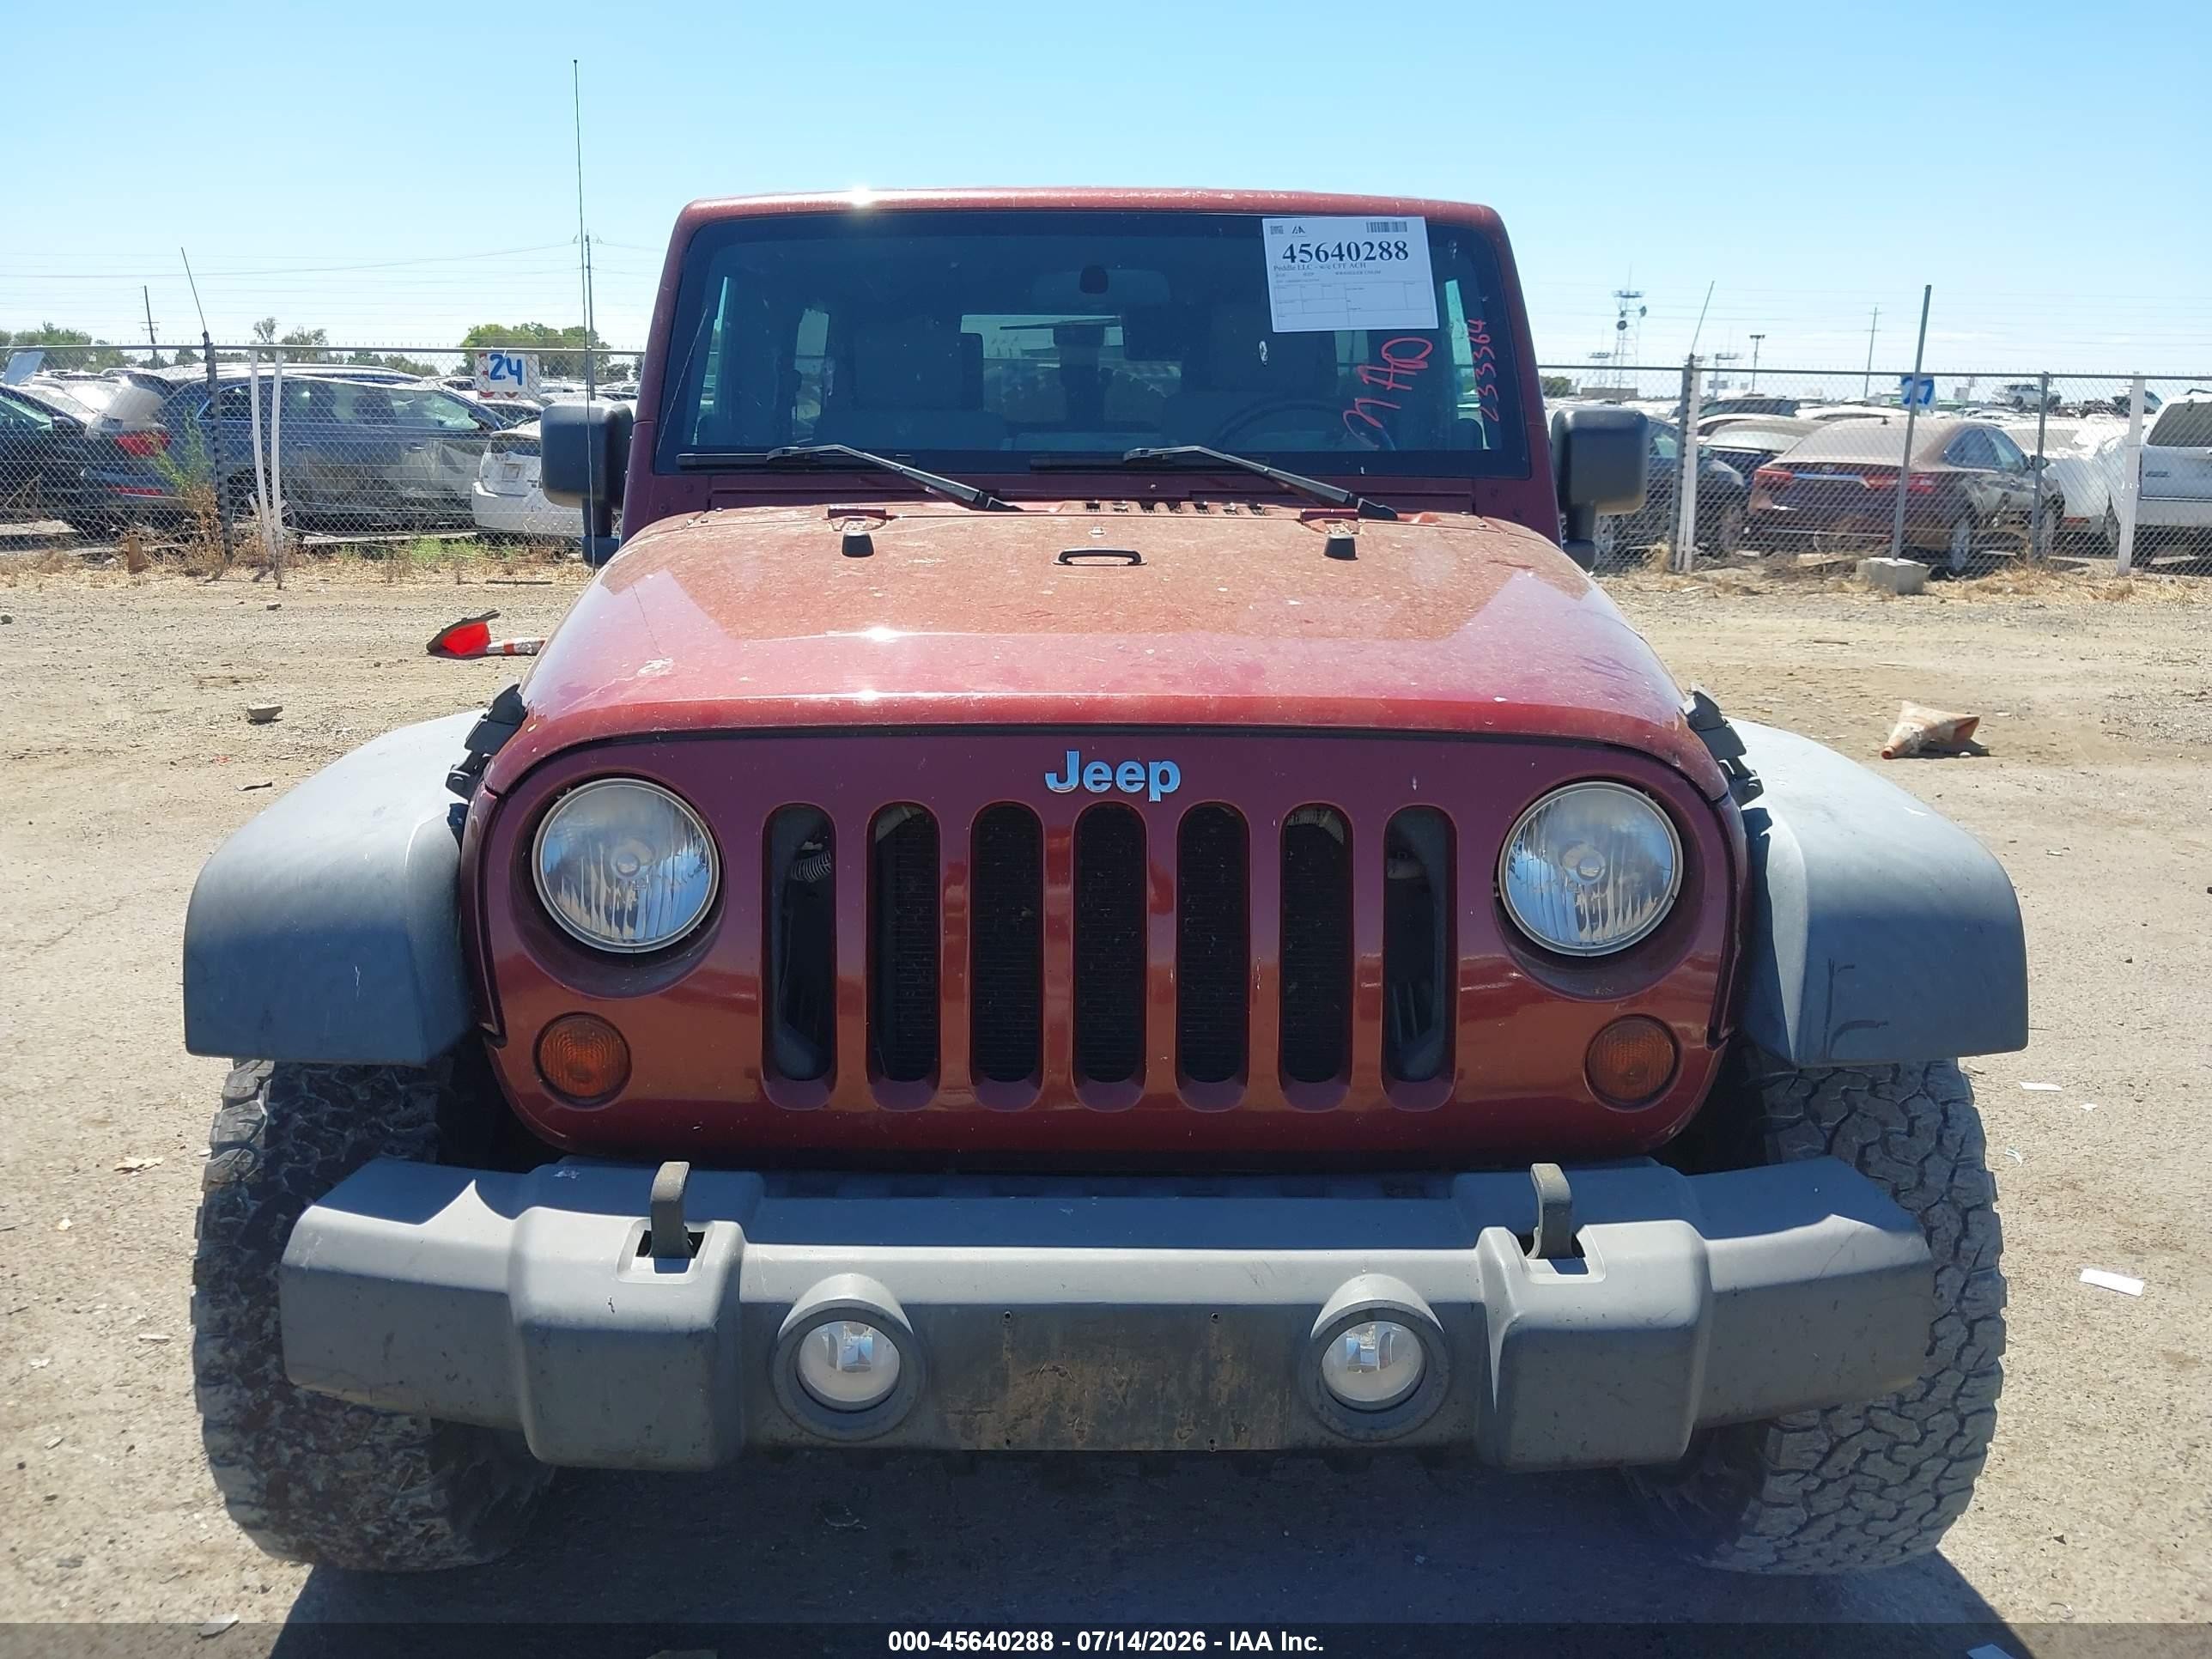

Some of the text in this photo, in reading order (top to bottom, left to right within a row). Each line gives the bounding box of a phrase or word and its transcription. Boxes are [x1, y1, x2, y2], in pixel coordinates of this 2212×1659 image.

[1282, 240, 1409, 264] 45640288
[489, 354, 523, 386] 24
[1044, 750, 1182, 802] Jeep
